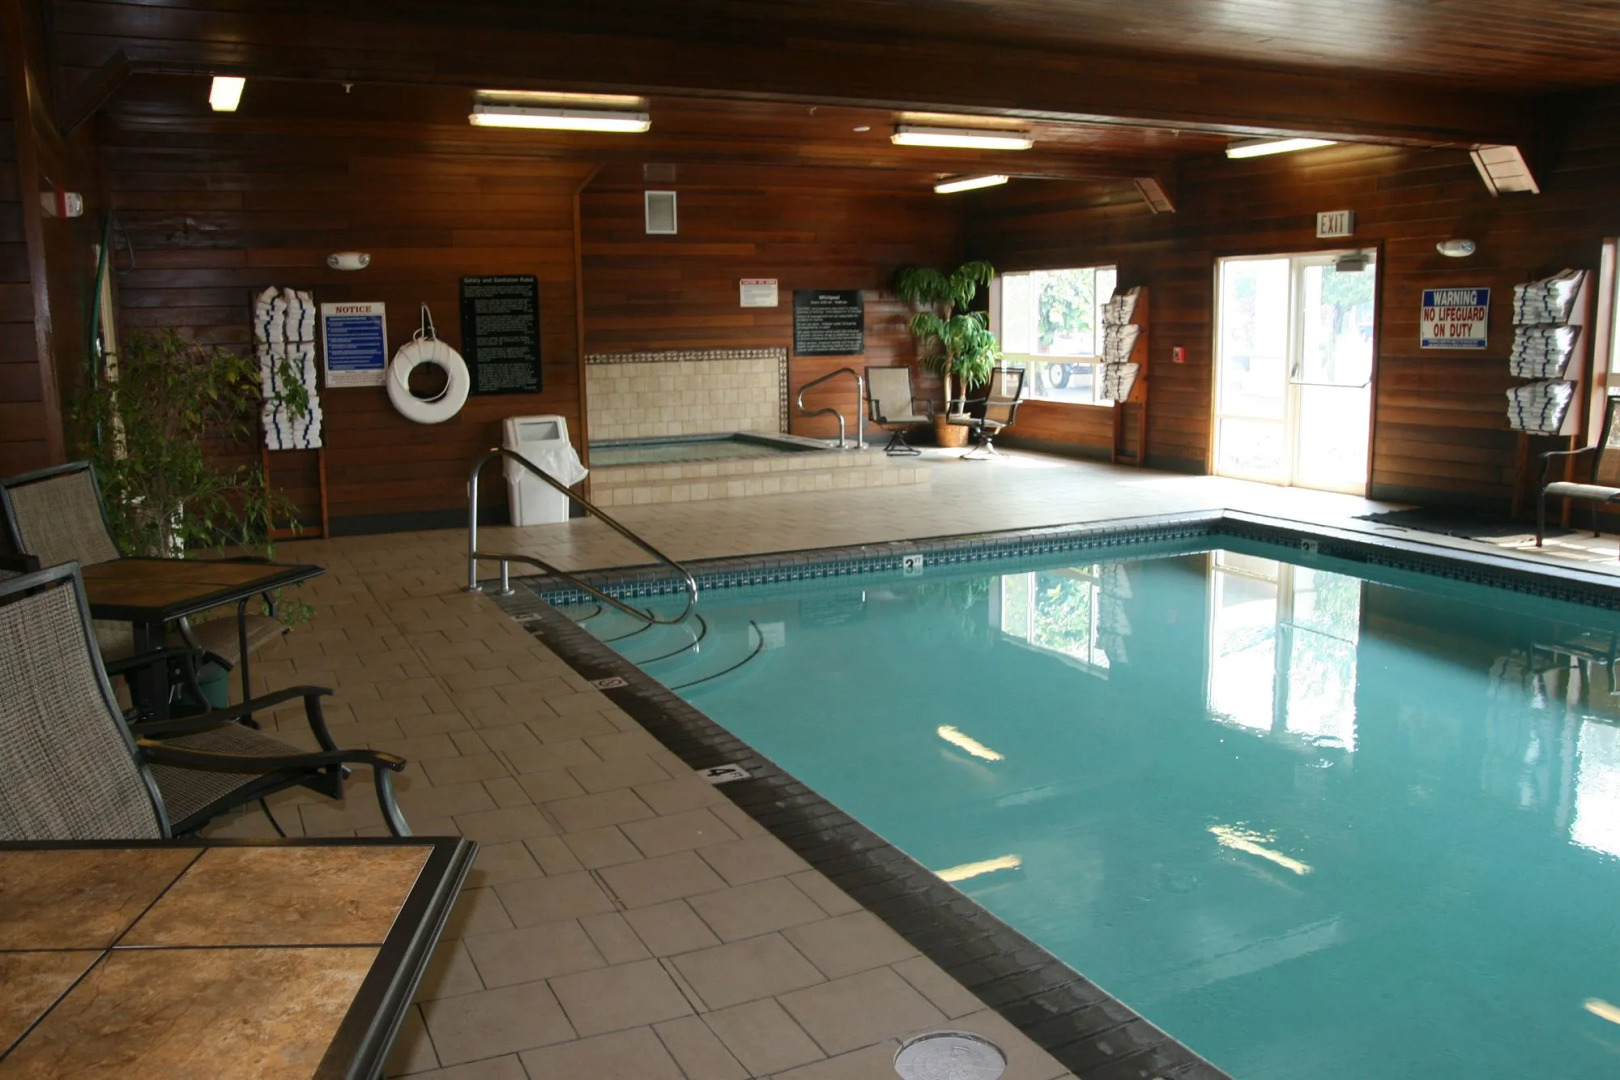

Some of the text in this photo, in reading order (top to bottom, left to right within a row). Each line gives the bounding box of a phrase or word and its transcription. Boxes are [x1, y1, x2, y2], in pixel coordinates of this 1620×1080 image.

[1321, 213, 1345, 234] EXIT
[1434, 290, 1478, 306] WARNING
[335, 305, 372, 314] NOTICE
[1424, 307, 1485, 322] NO LIFEGUARD
[1434, 323, 1473, 338] ON DUTY
[707, 768, 738, 777] 4
